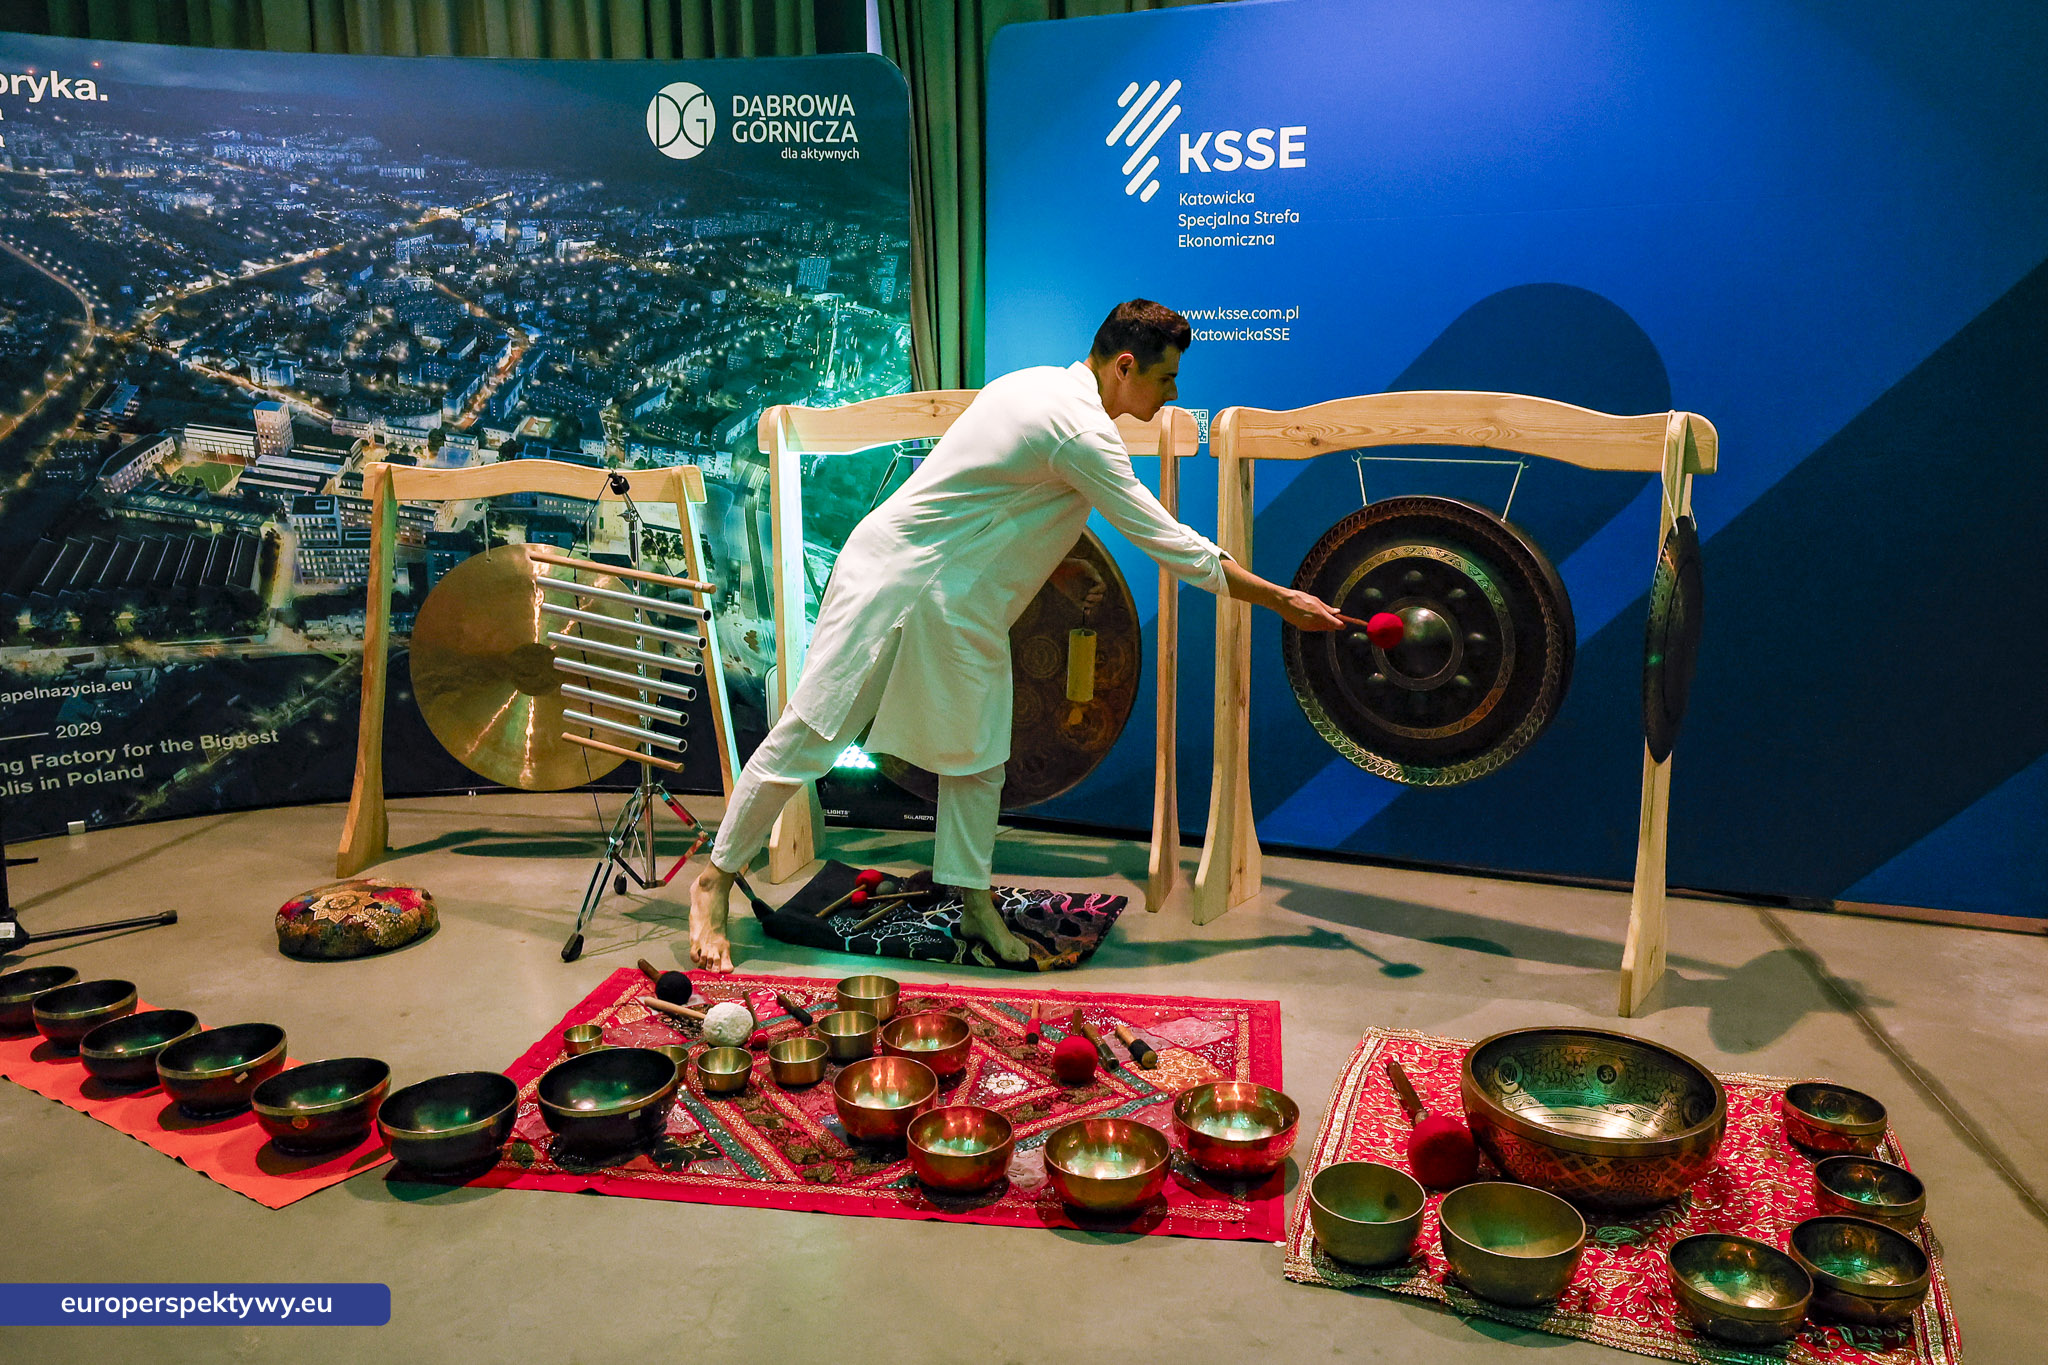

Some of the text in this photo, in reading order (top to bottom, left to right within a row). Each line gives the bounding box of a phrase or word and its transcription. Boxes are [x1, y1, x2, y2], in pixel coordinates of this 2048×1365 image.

[732, 94, 856, 121] DĄBROWA
[732, 117, 859, 143] GÓRNICZA
[781, 147, 860, 162] dla aktywnych
[1179, 125, 1307, 174] KSSE
[1179, 190, 1255, 206] Katowicka
[1178, 209, 1300, 230] Specjalna Strefa
[1178, 234, 1275, 248] Ekonomiczna
[1178, 305, 1299, 322] www.ksse.com.pl
[1191, 327, 1290, 341] KatowickaSSE
[55, 721, 102, 739] 2029
[30, 748, 117, 769] Factory
[122, 743, 153, 758] for
[160, 739, 193, 753] the
[200, 729, 279, 750] Biggest
[39, 776, 61, 791] in
[67, 763, 145, 787] Poland
